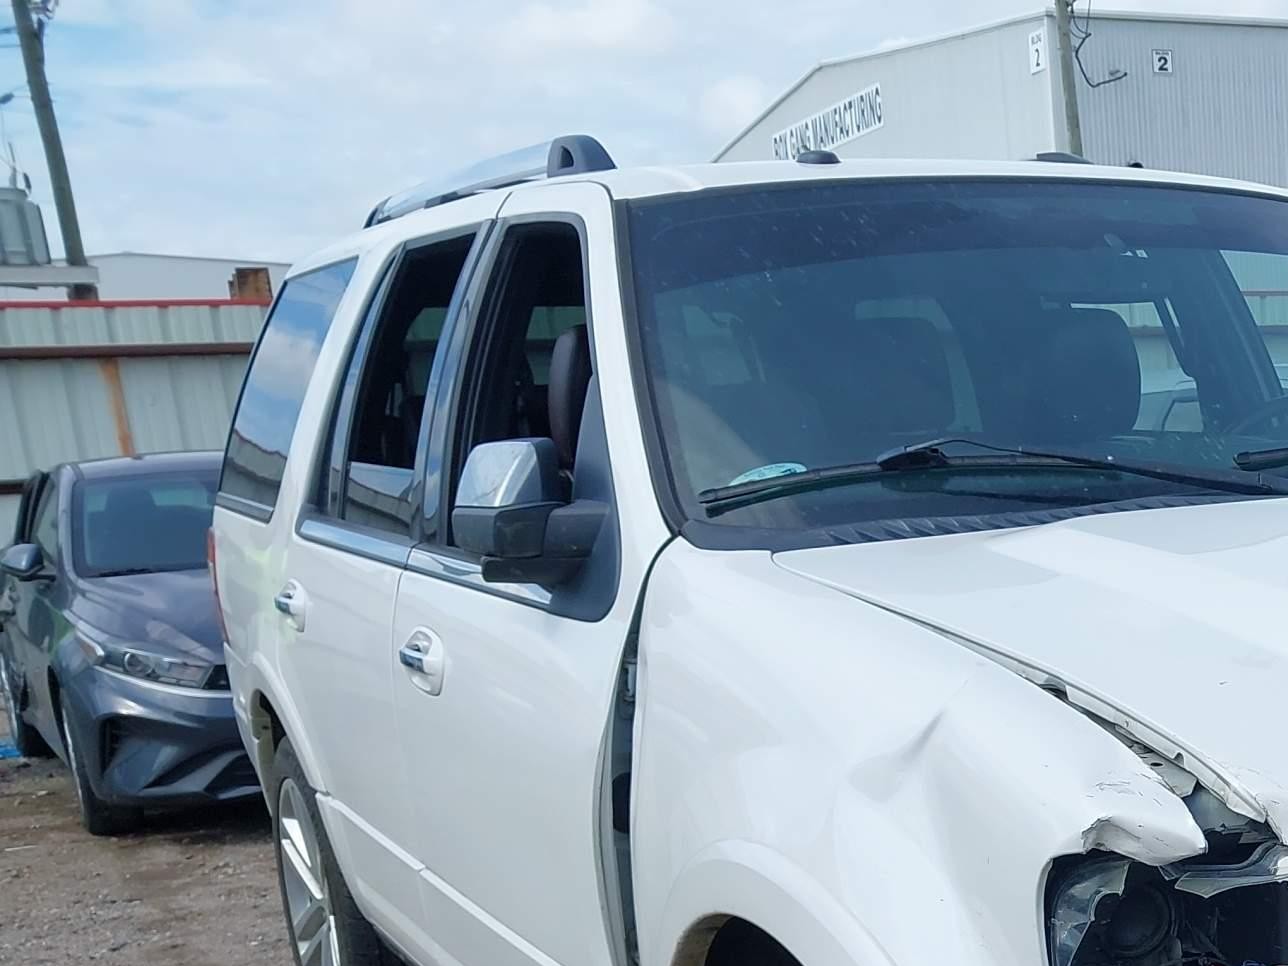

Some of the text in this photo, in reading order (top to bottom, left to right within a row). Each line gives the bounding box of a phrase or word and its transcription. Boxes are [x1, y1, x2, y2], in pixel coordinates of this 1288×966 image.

[1034, 48, 1041, 67] 2
[1157, 56, 1169, 72] 2
[811, 87, 883, 151] MANUFACTURING
